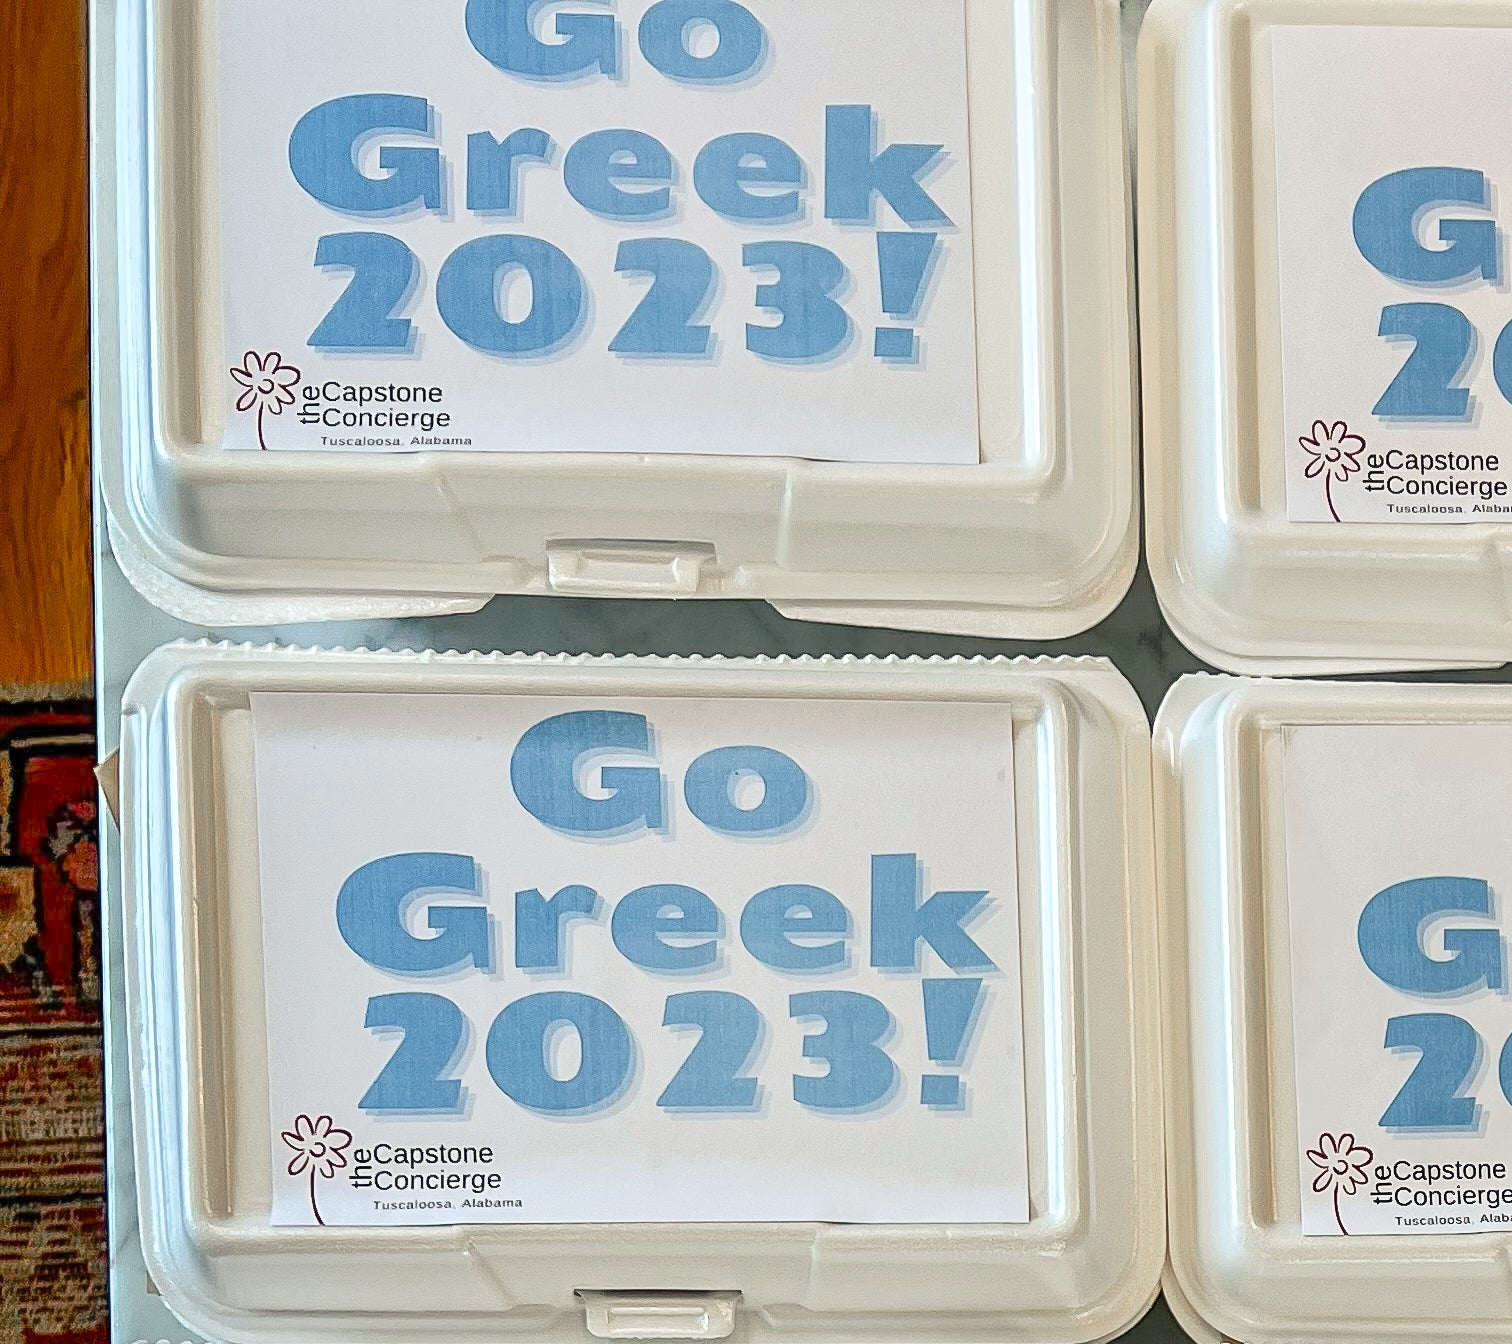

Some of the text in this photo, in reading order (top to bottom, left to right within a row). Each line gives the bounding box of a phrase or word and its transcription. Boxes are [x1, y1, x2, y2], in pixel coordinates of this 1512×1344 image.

[465, 0, 769, 86] Go
[288, 93, 955, 228] Greek
[307, 231, 942, 365] 2023!
[296, 385, 321, 425] the
[321, 381, 443, 408] Capstone
[322, 407, 451, 432] Concierge
[410, 435, 472, 446] Alabama
[1361, 453, 1385, 493] the
[1385, 449, 1500, 476] Capstone
[1386, 475, 1508, 501] Concierge
[510, 710, 813, 838] Go
[336, 852, 998, 978] Greek
[358, 978, 986, 1116] 2023!
[348, 1148, 373, 1189] the
[373, 1143, 494, 1170] Capstone
[1393, 1160, 1506, 1186] Capstone
[374, 1168, 502, 1194] Concierge
[1369, 1165, 1394, 1206] the
[461, 1198, 523, 1208] Alabama
